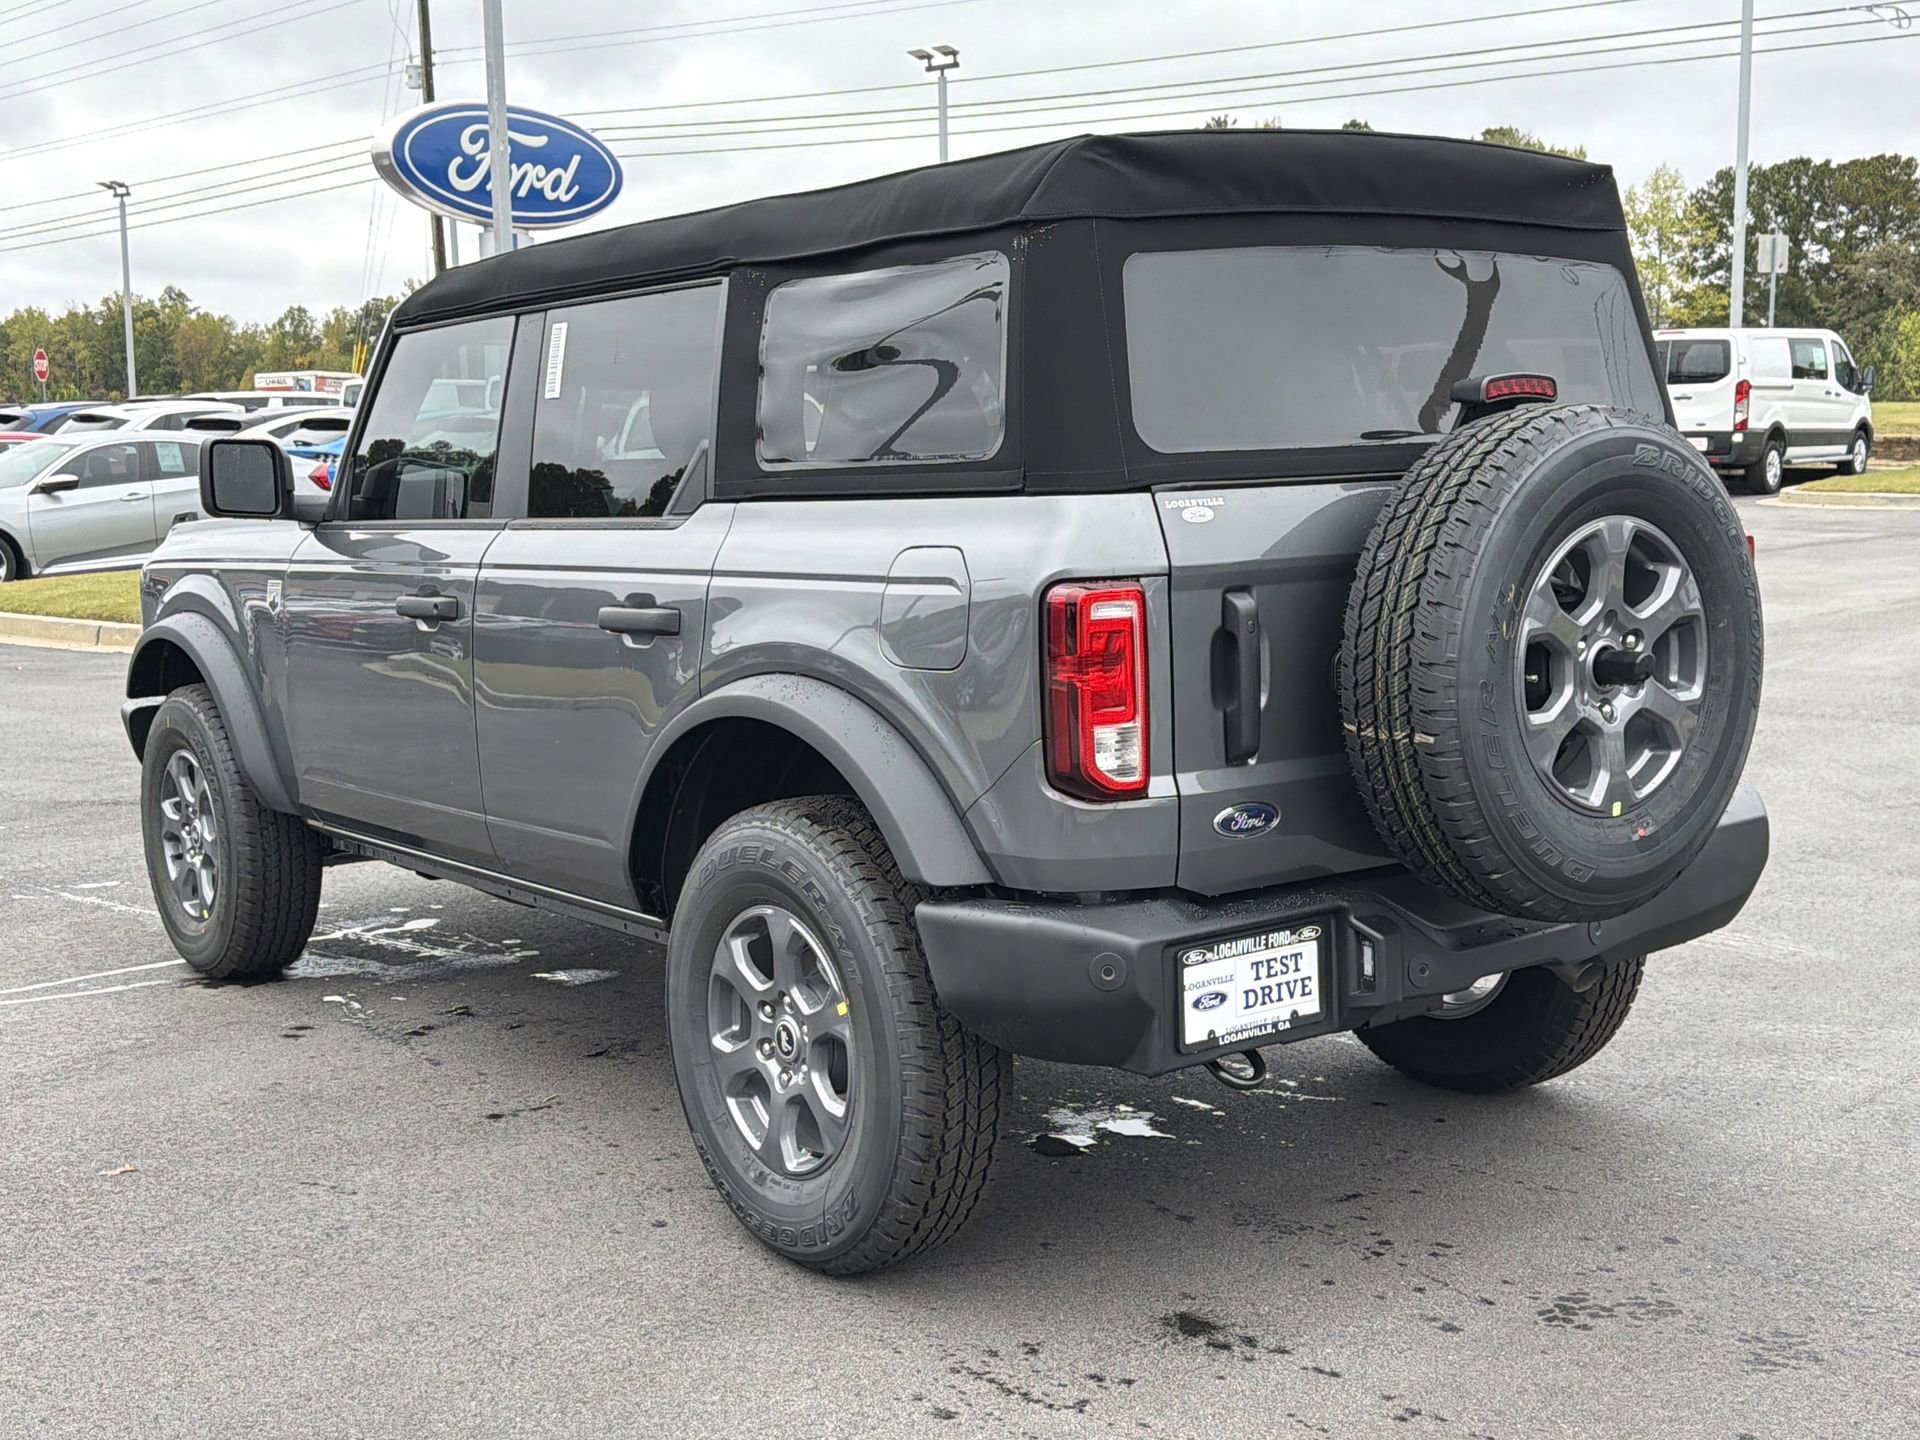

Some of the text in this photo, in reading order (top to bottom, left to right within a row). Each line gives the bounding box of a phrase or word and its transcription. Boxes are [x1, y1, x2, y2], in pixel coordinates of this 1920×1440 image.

[448, 123, 582, 203] Frd
[34, 359, 48, 372] STOP
[1164, 497, 1225, 509] LOGANVILLE
[1632, 442, 1763, 711] BRIDGESTONE
[1480, 679, 1598, 884] DUELER
[1231, 811, 1265, 830] Ford
[699, 846, 829, 915] DUELER
[1213, 930, 1291, 959] LOGANVILLE FORD
[1251, 952, 1303, 982] TEST
[1184, 974, 1235, 992] LOGANVILLE
[1243, 976, 1312, 1010] DRIVE
[1198, 992, 1222, 1010] Ford
[1219, 1020, 1291, 1046] LOGANVILLE, GA
